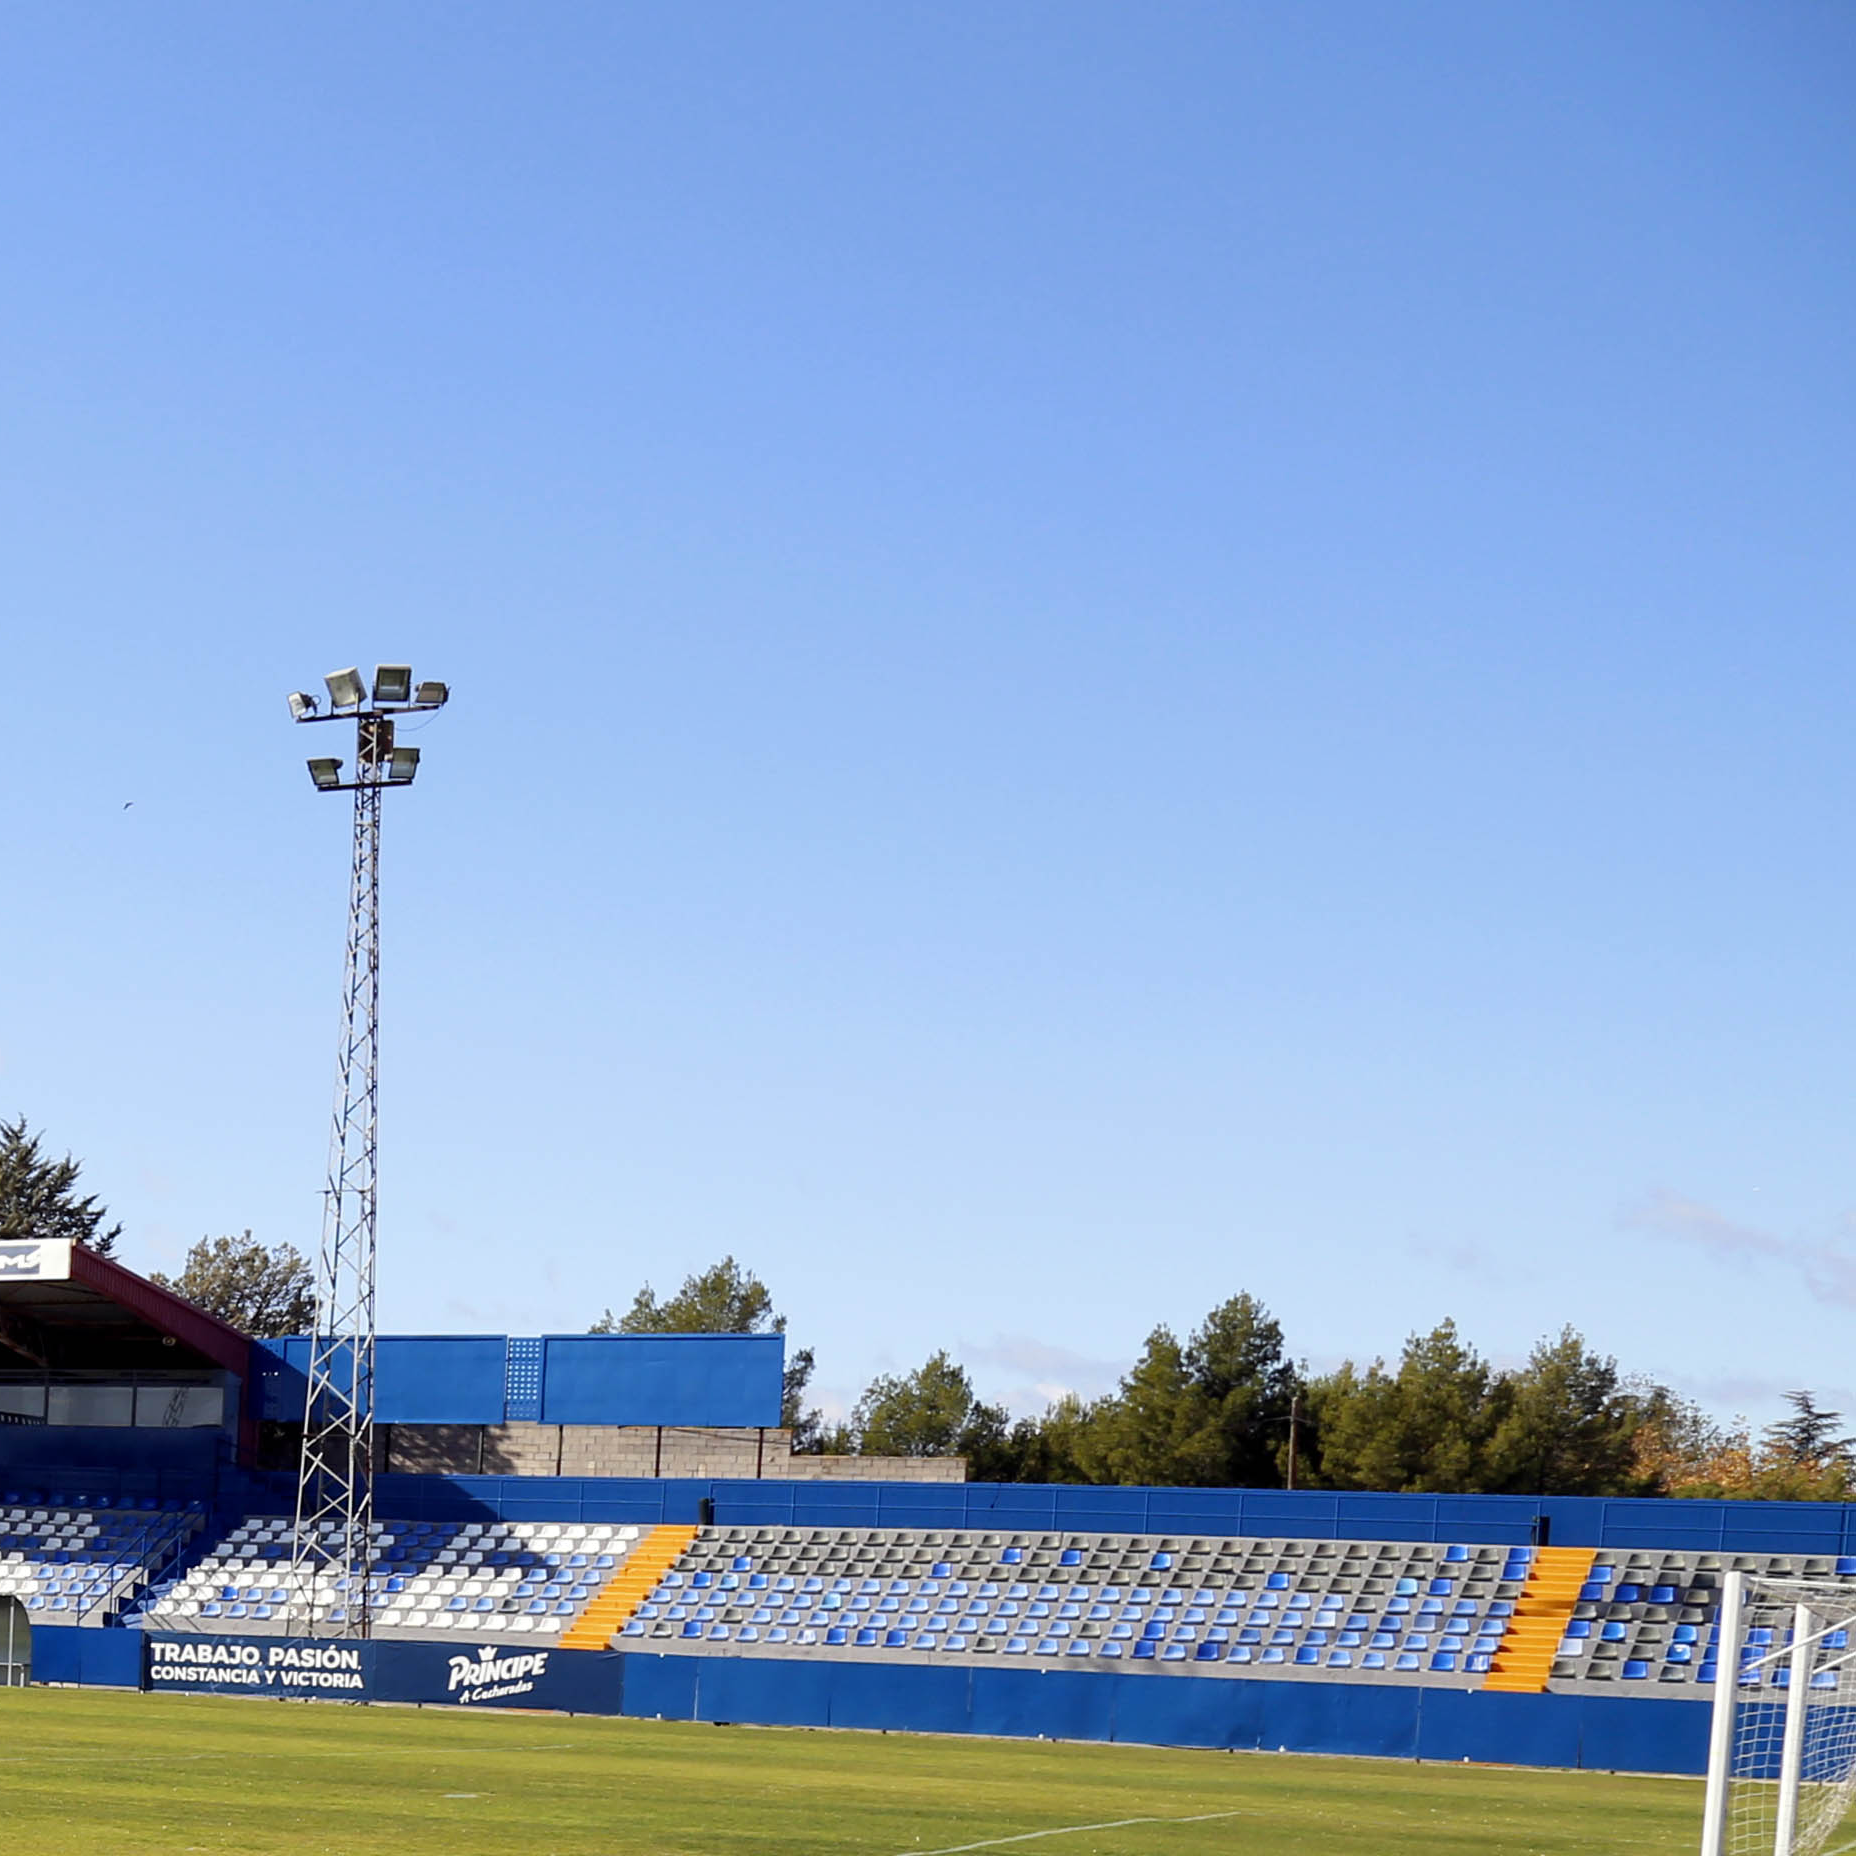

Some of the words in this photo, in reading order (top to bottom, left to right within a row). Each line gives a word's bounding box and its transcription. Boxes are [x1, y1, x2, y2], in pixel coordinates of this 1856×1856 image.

[150, 1642, 263, 1666] TRABAJO,
[269, 1644, 362, 1671] PASIÓN,
[150, 1665, 260, 1684] CONSTANCIA
[264, 1669, 277, 1684] Y
[281, 1670, 364, 1689] VICTORIA
